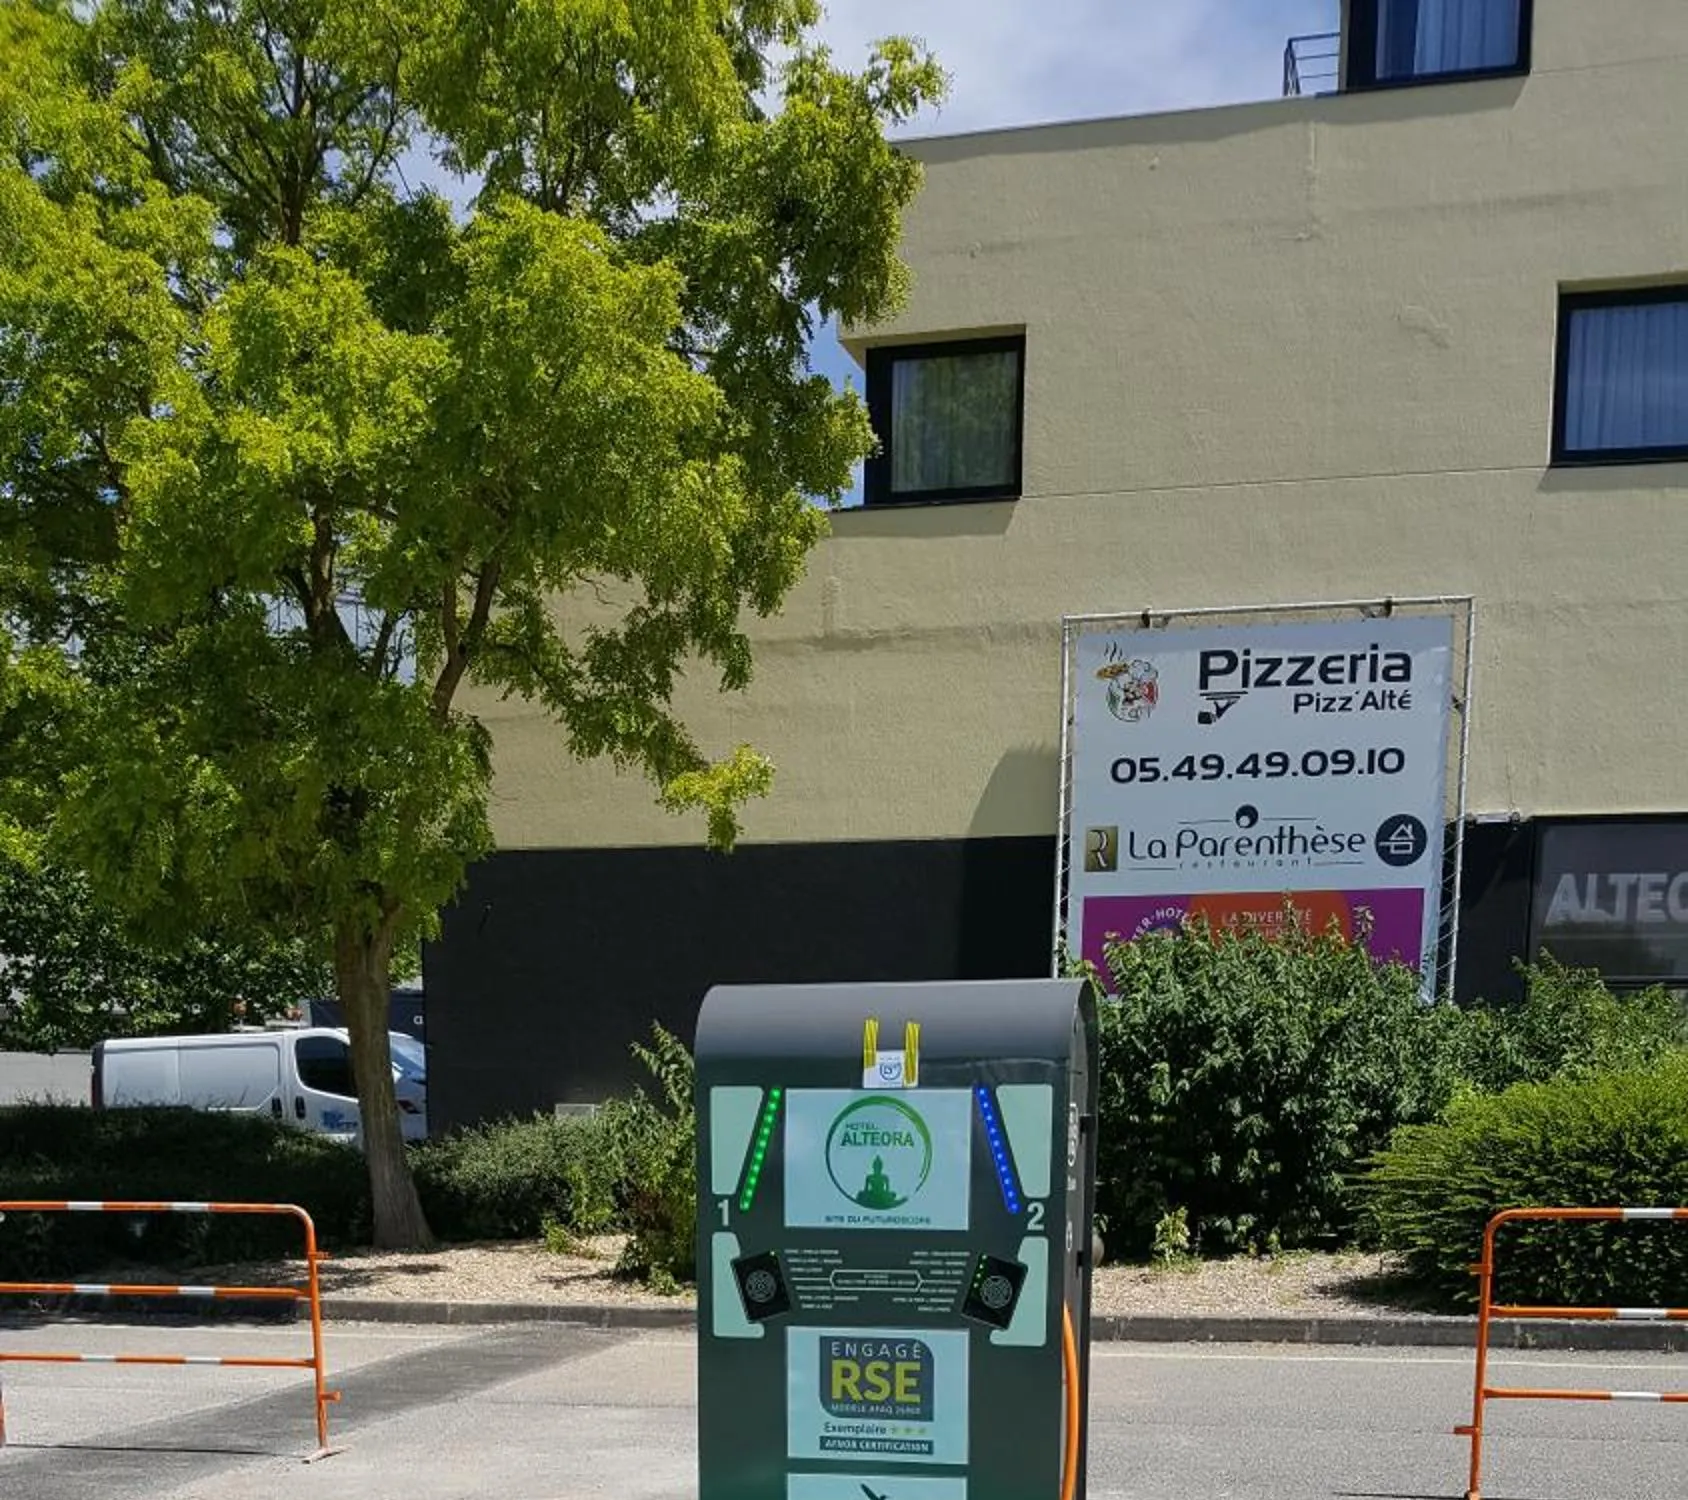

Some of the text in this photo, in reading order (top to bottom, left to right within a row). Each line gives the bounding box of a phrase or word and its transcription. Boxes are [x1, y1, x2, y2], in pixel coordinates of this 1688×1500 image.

[1199, 643, 1411, 690] Pizzeria
[1110, 748, 1405, 784] 05.49.49.09.10
[717, 1199, 729, 1227] 1
[1027, 1202, 1045, 1231] 2
[831, 1342, 922, 1359] ENGAGÉ
[831, 1360, 921, 1403] RSE
[824, 1421, 887, 1436] Exemplaire
